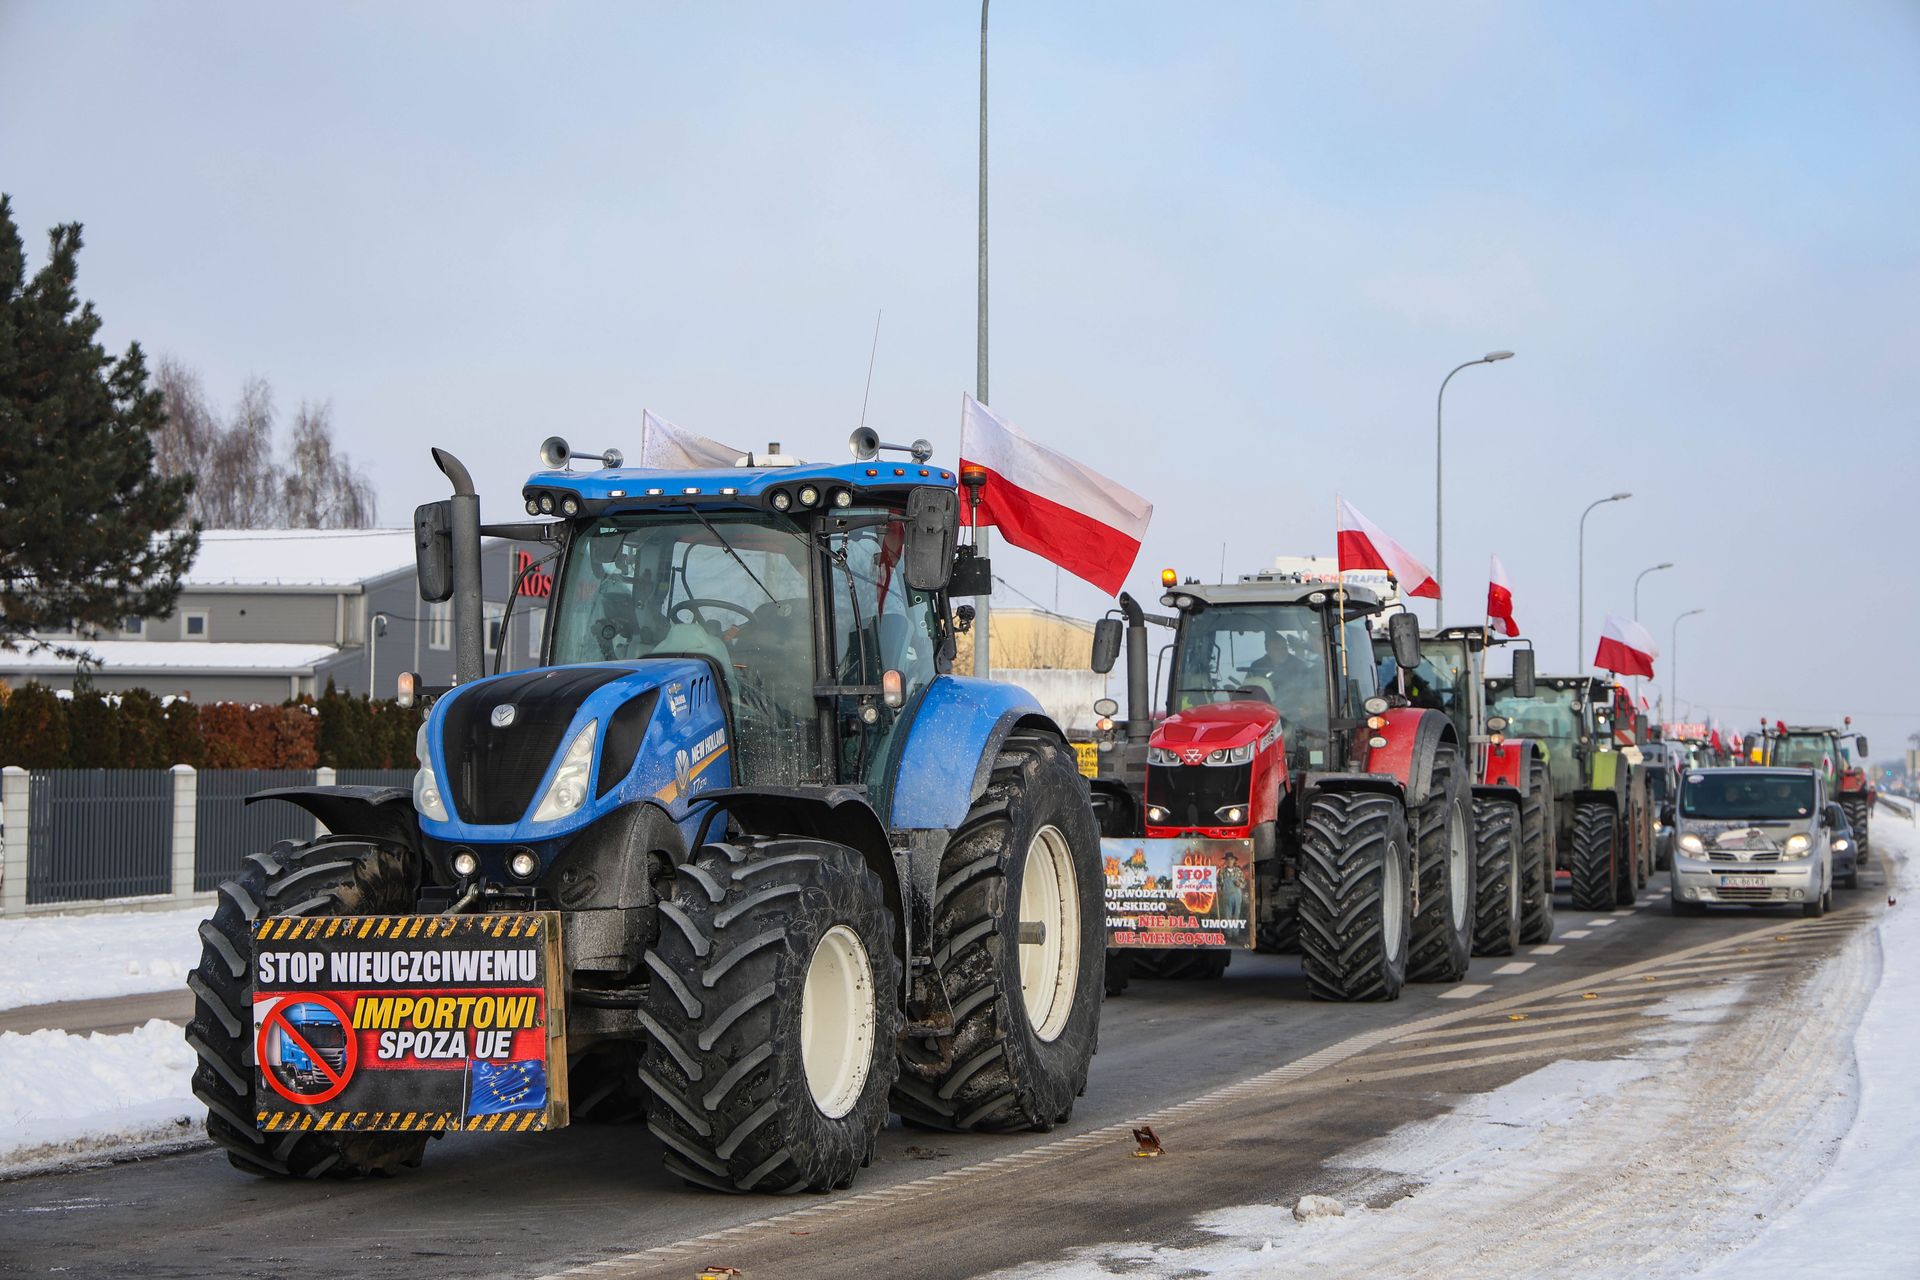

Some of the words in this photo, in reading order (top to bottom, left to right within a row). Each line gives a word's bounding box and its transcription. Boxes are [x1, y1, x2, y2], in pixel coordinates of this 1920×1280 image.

[691, 740, 705, 765] NEW
[705, 727, 726, 755] HOLLAND
[1176, 868, 1213, 880] STOP
[1104, 887, 1185, 900] OJEWÓDZTWA
[1105, 901, 1167, 912] OLSKIEGO
[1105, 915, 1137, 930] ÓWIĄ
[1138, 915, 1166, 928] NIE
[1168, 915, 1199, 928] DLA
[1201, 919, 1247, 929] UMOWY
[1114, 931, 1226, 945] UE-MERCOSUR
[258, 951, 324, 984] STOP
[330, 949, 537, 983] NIEUCZCIWEMU
[352, 996, 537, 1029] IMPORTOWI
[377, 1030, 467, 1059] SPOZA
[475, 1030, 512, 1058] UE
